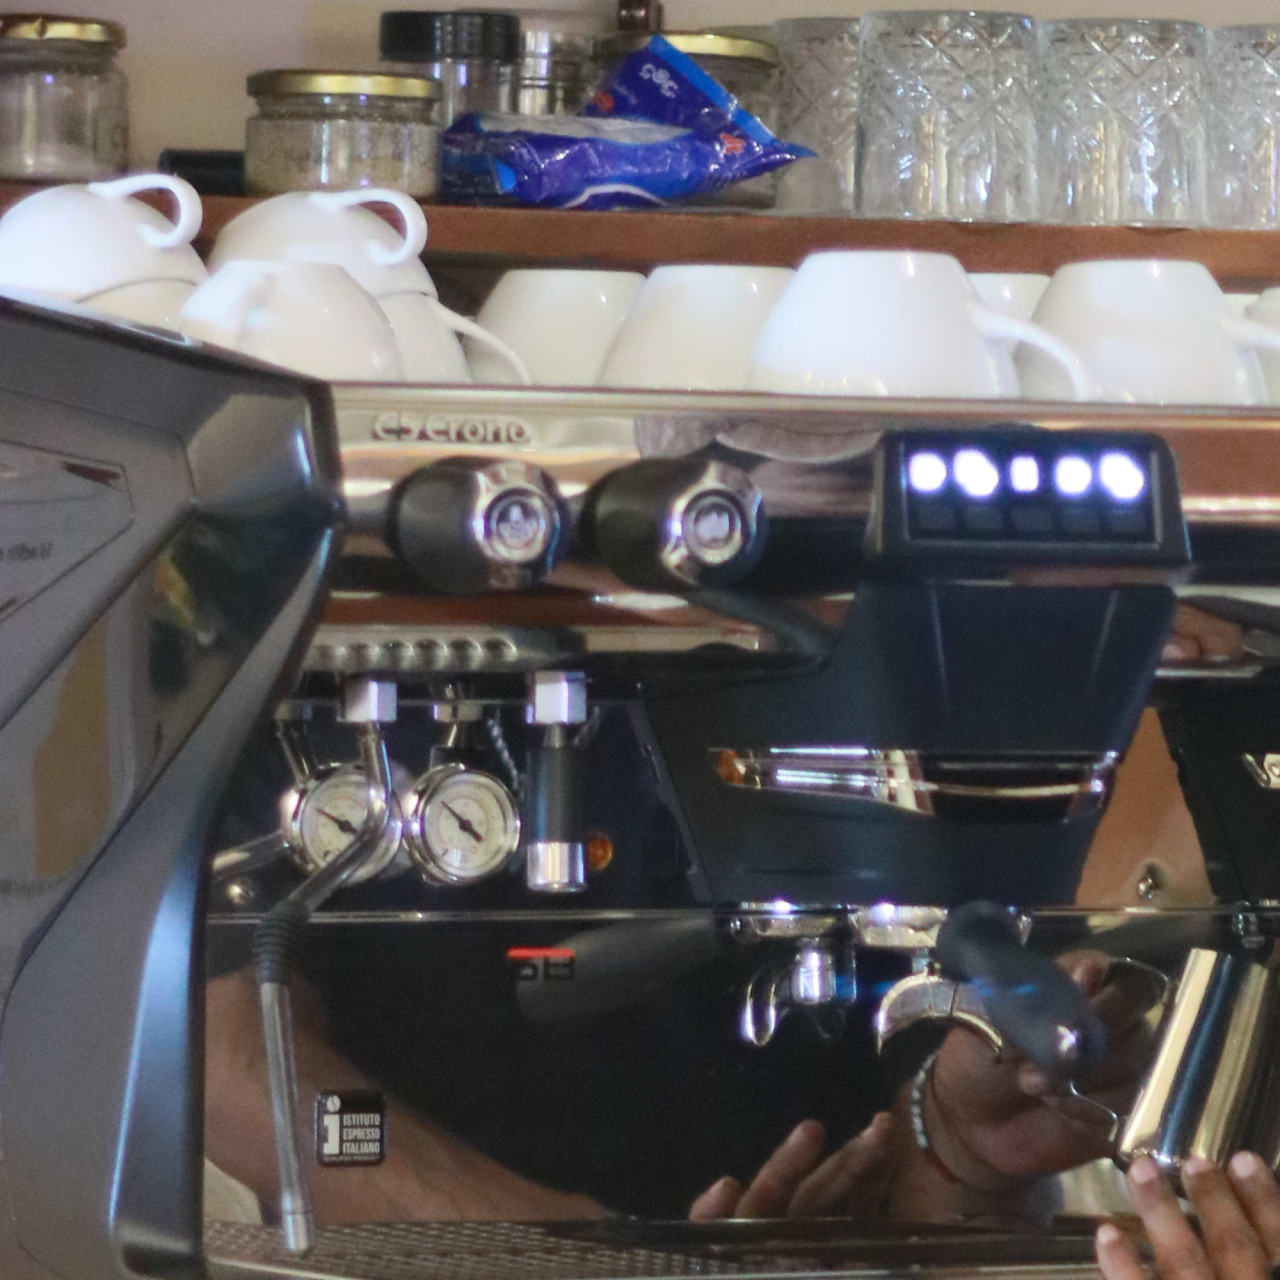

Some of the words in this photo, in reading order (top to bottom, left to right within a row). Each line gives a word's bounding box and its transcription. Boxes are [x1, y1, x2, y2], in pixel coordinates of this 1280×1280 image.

[343, 1113, 381, 1126] ISTITUTO
[343, 1127, 380, 1140] ESPRESSO
[343, 1141, 380, 1154] ITALIANO
